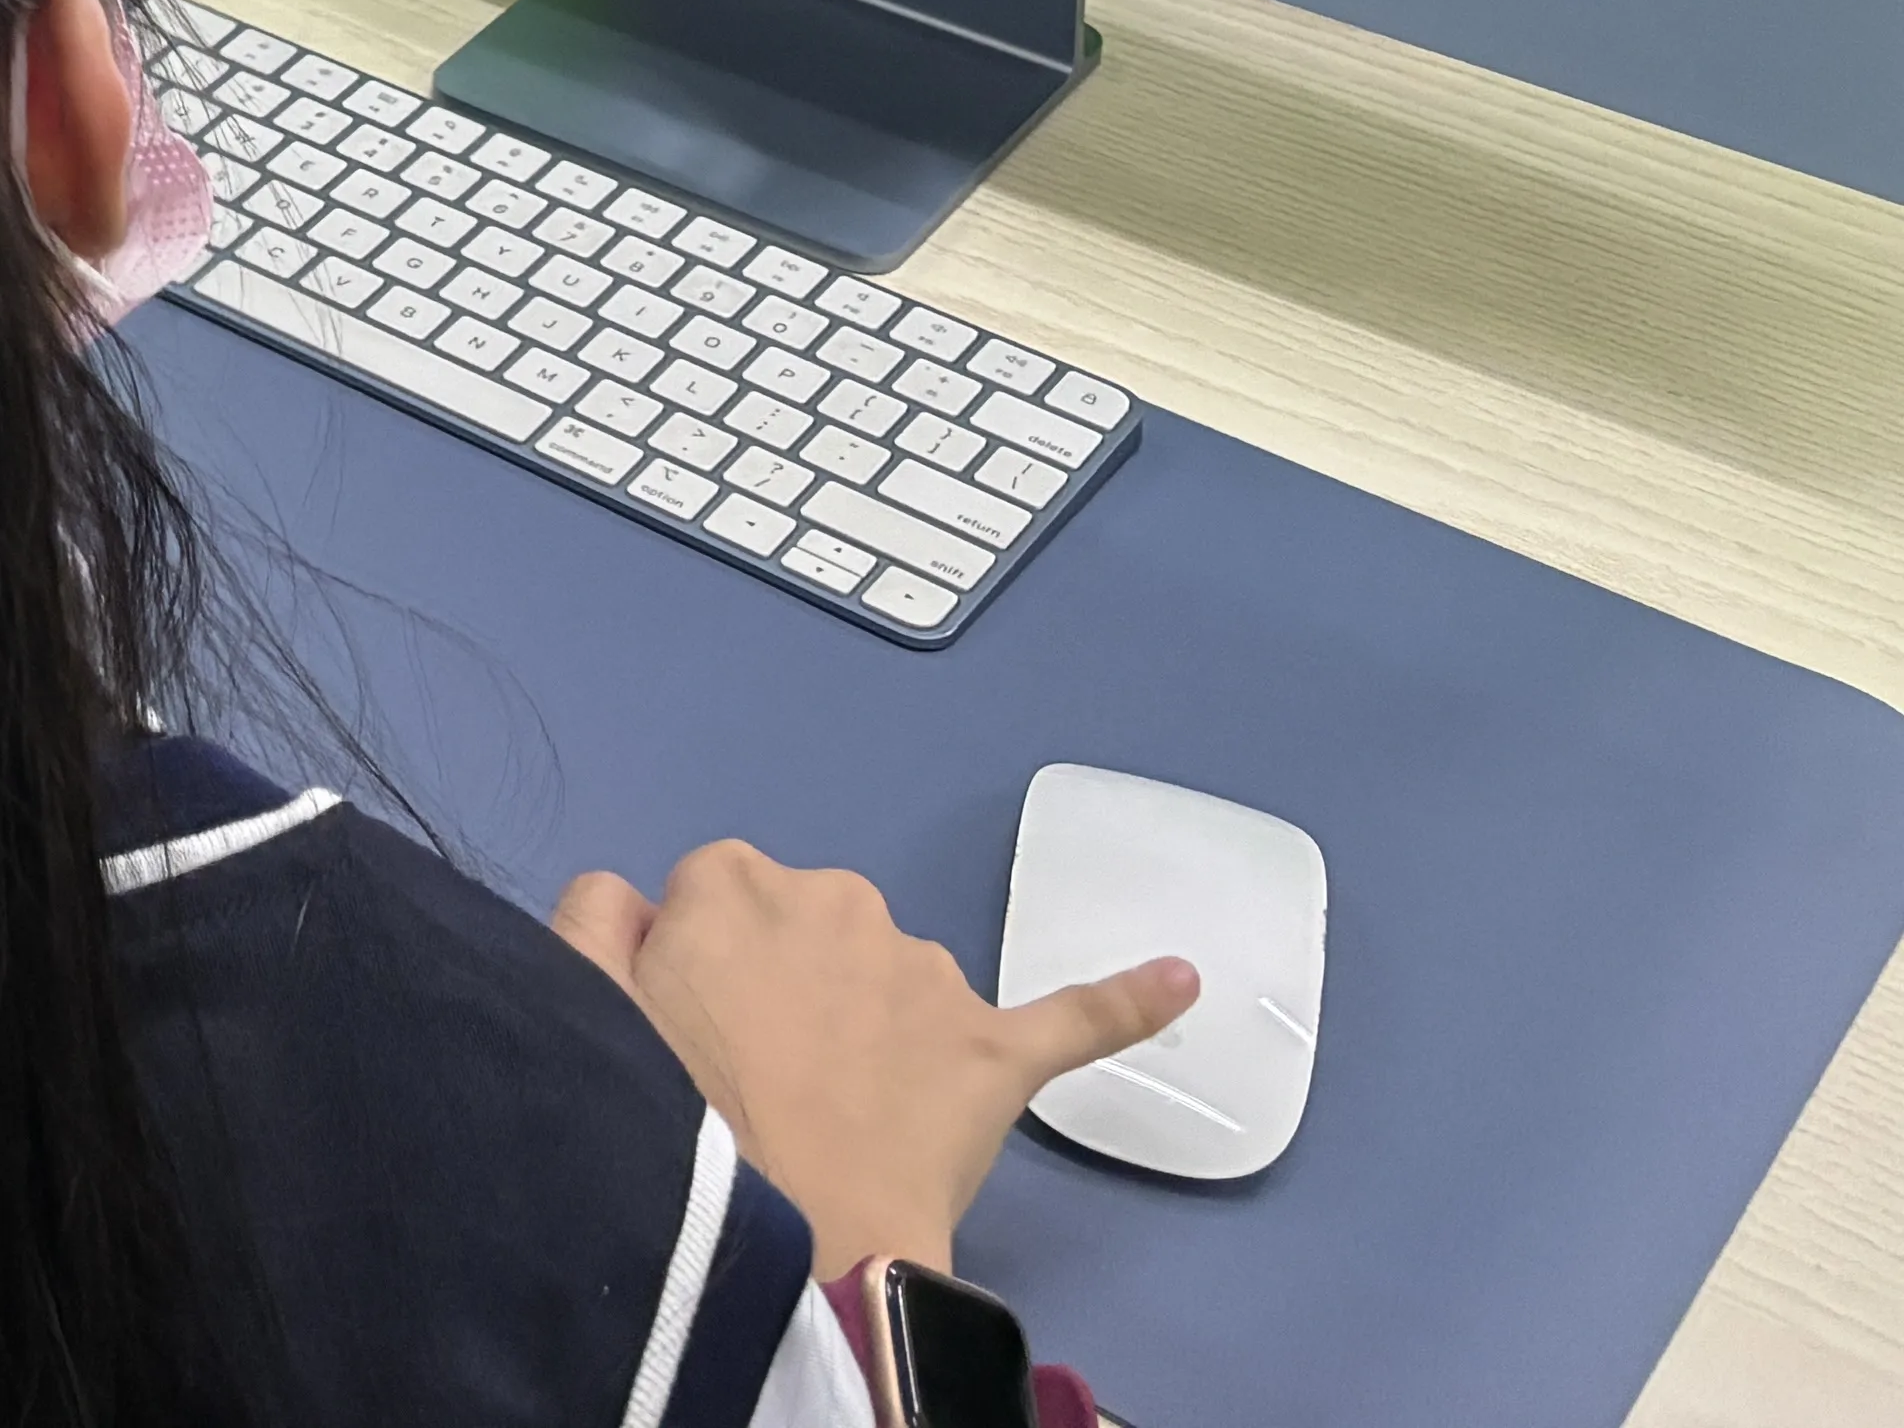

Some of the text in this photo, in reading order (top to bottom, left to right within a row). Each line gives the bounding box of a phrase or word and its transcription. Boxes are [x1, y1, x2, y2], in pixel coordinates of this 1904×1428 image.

[1028, 435, 1072, 457] delete
[641, 485, 684, 508] option
[957, 514, 1001, 538] return
